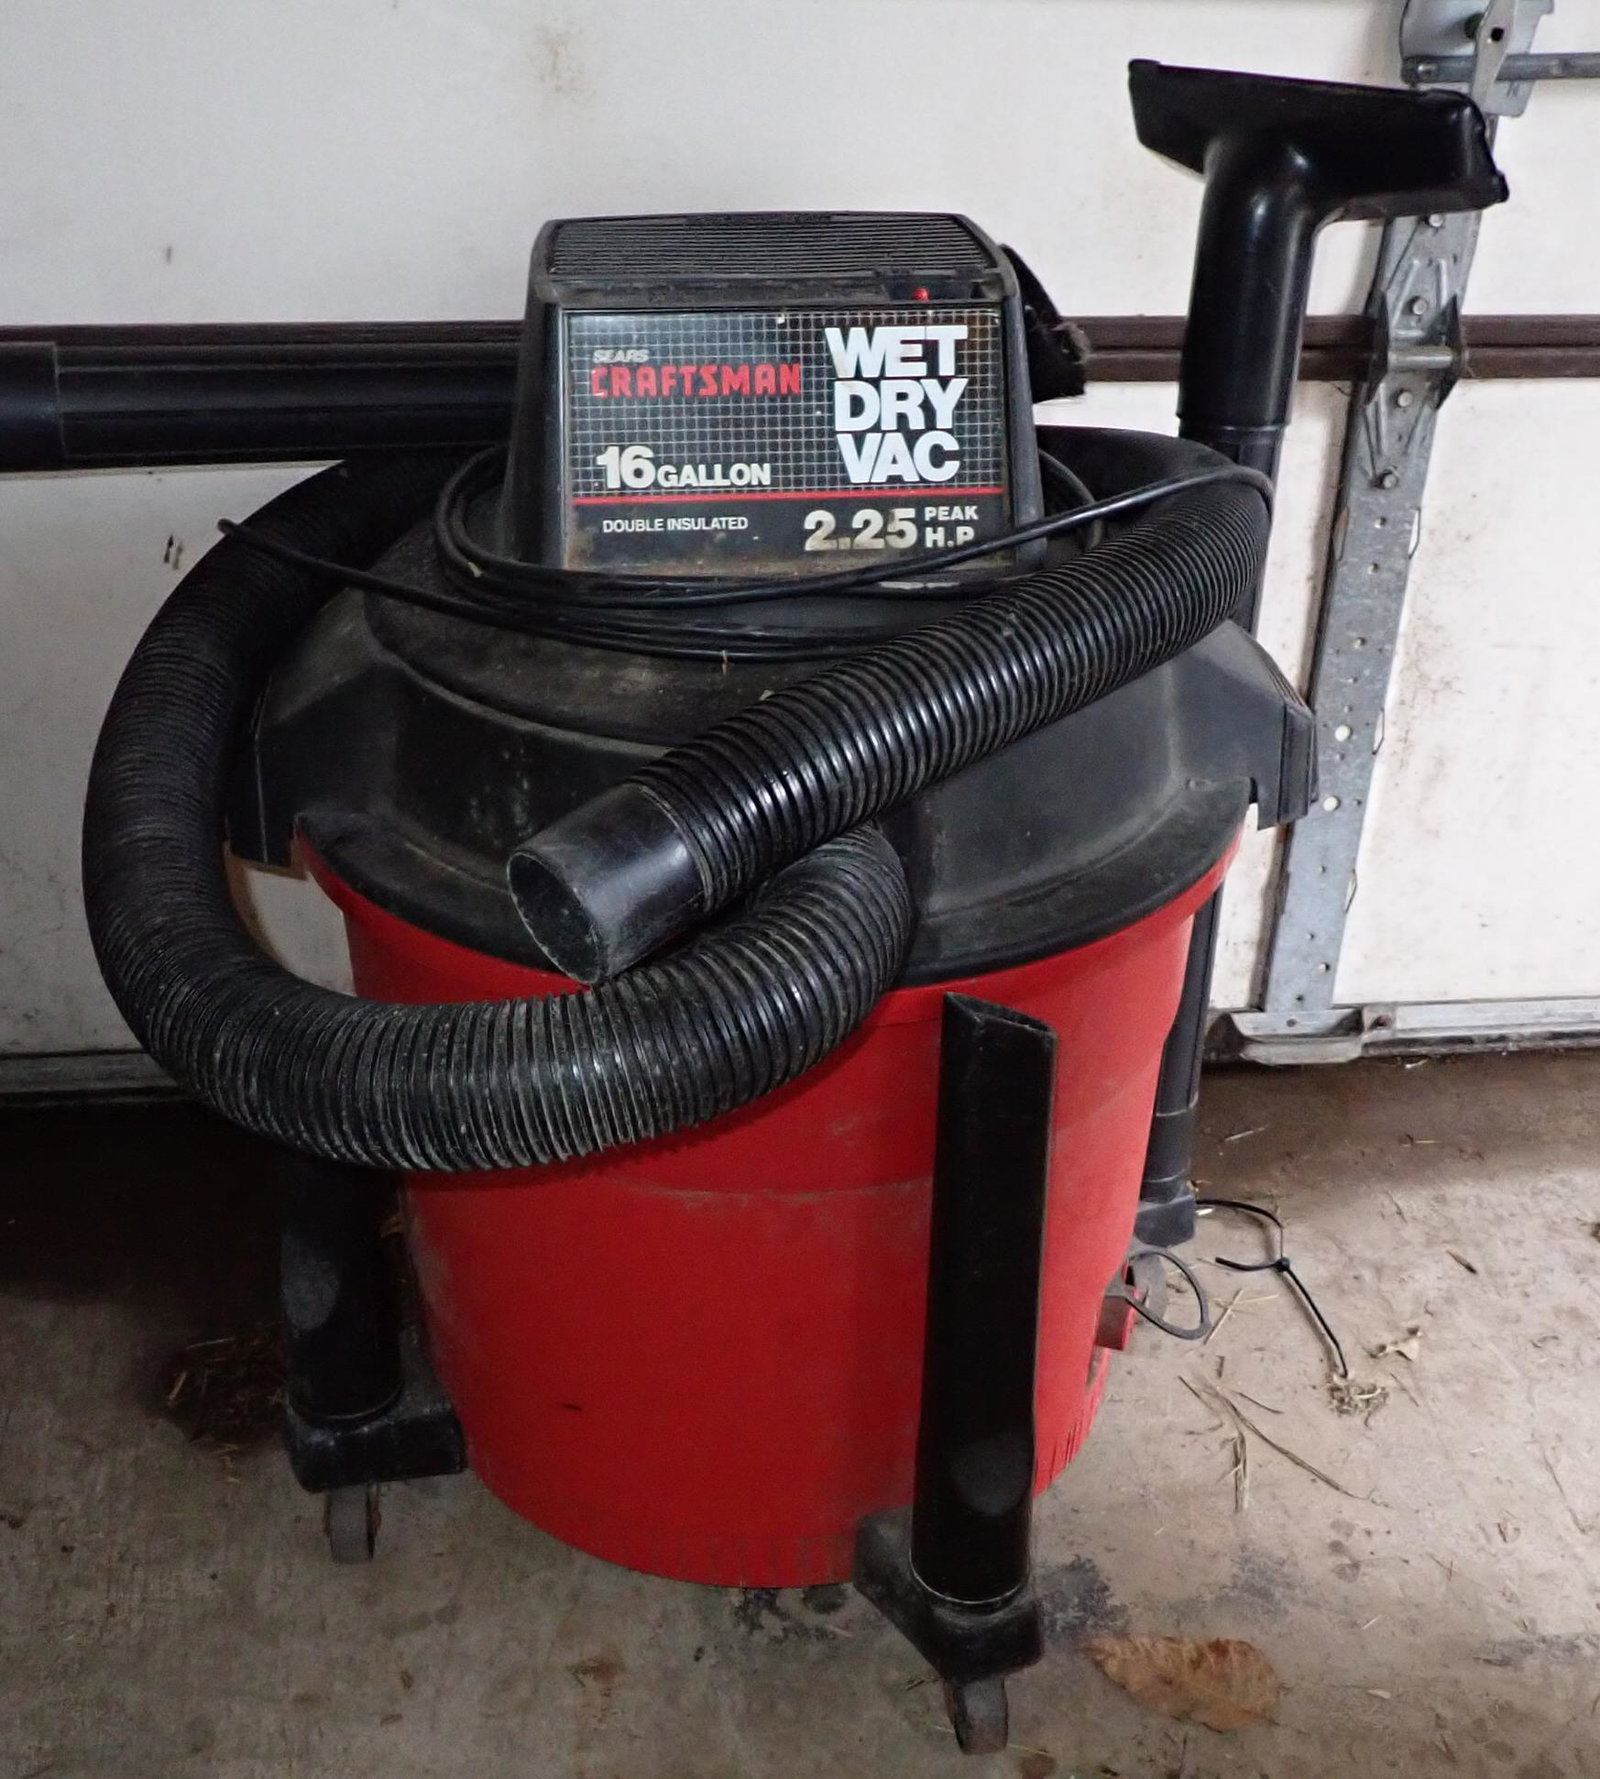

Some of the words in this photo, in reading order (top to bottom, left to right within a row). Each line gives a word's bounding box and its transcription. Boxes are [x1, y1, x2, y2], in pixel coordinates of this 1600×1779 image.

[593, 349, 649, 363] SEARS
[825, 325, 968, 378] WET
[591, 363, 800, 398] CRAFTSMAN
[834, 378, 969, 431] DRY
[596, 445, 656, 488] 16
[657, 463, 772, 487] GALLON
[836, 430, 960, 483] VAC
[603, 518, 664, 533] DOUBLE
[667, 516, 748, 532] INSULATED
[803, 508, 918, 551] 2.25
[924, 505, 979, 522] PEAK
